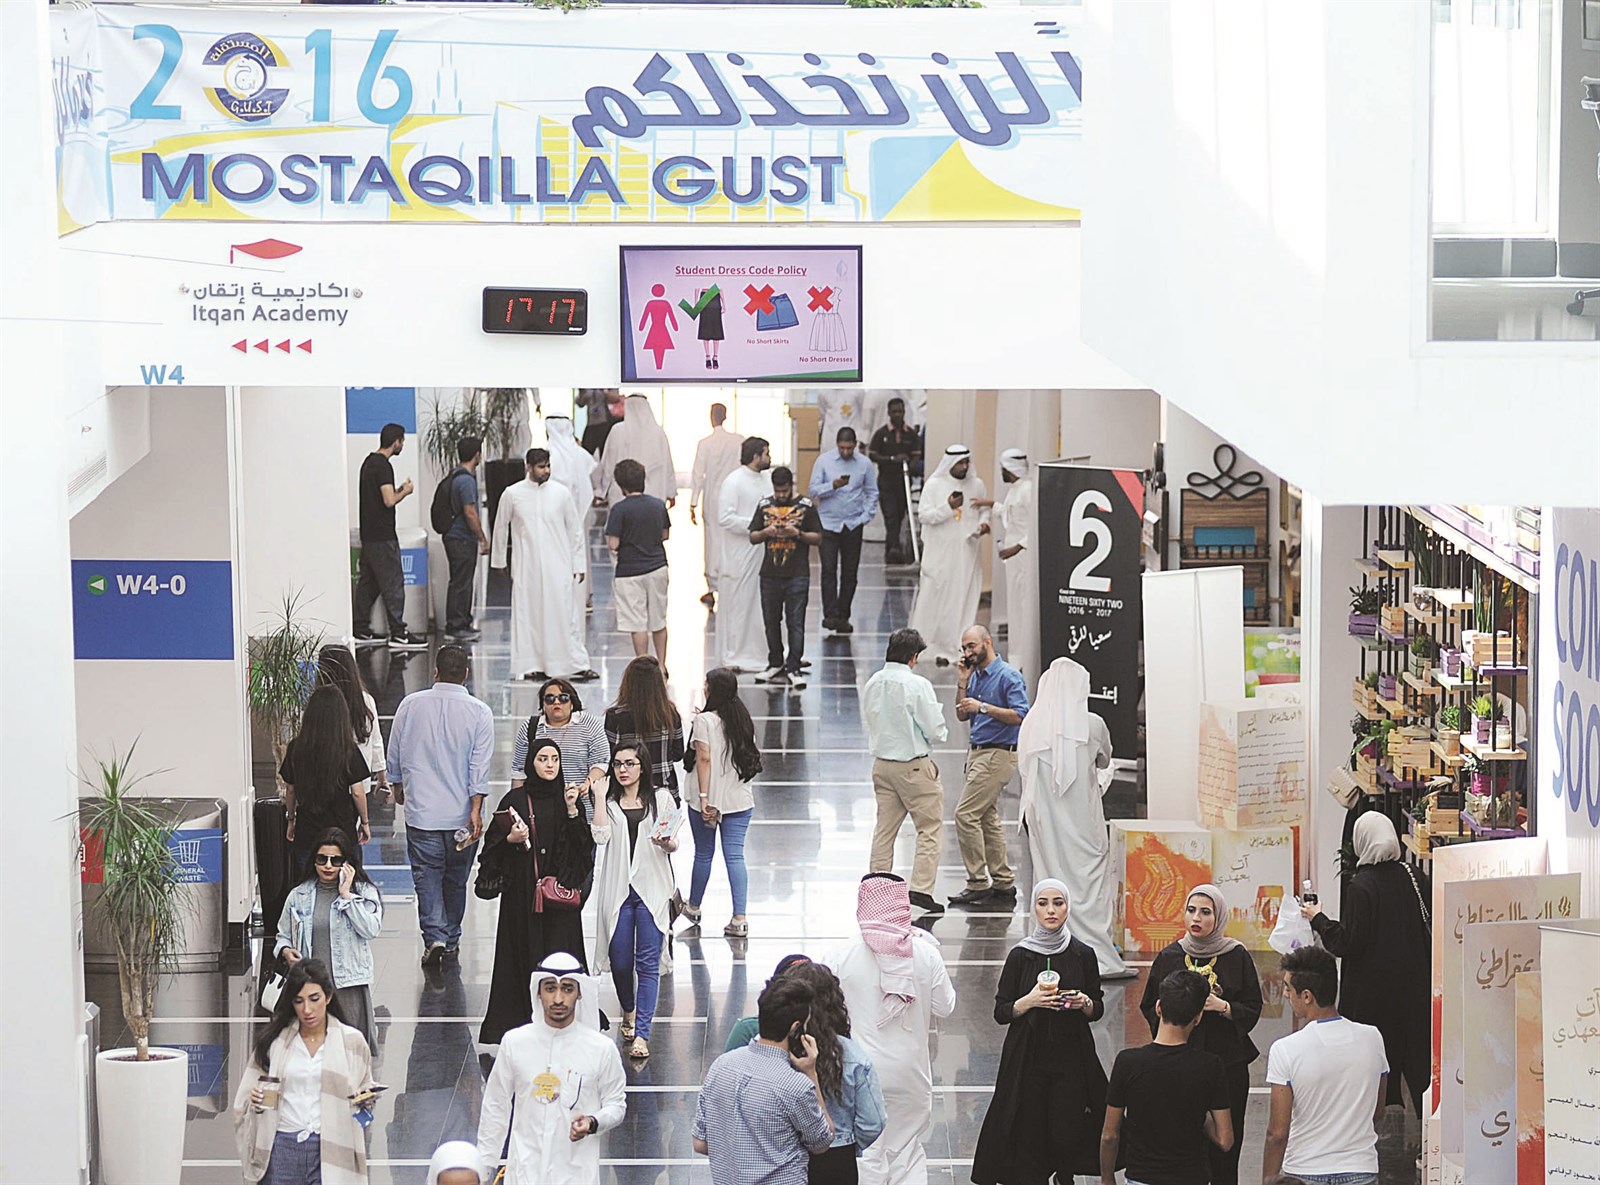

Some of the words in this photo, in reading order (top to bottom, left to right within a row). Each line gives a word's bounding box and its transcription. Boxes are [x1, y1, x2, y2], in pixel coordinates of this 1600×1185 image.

[141, 152, 626, 205] MOSTAQILLA
[652, 155, 844, 205] GUST
[675, 265, 715, 275] Student
[718, 265, 746, 275] Dress
[748, 265, 774, 275] Code
[777, 265, 807, 276] Policy
[193, 283, 246, 304] إتقان
[192, 304, 245, 326] Itqan
[252, 304, 348, 326] Academy
[140, 364, 185, 385] W4
[116, 574, 187, 596] W4-0
[1058, 595, 1088, 606] NINETEEN
[1088, 597, 1106, 607] SIXTY
[1106, 599, 1123, 609] TWO
[1068, 605, 1085, 615] 2016
[1096, 608, 1112, 617] 2017
